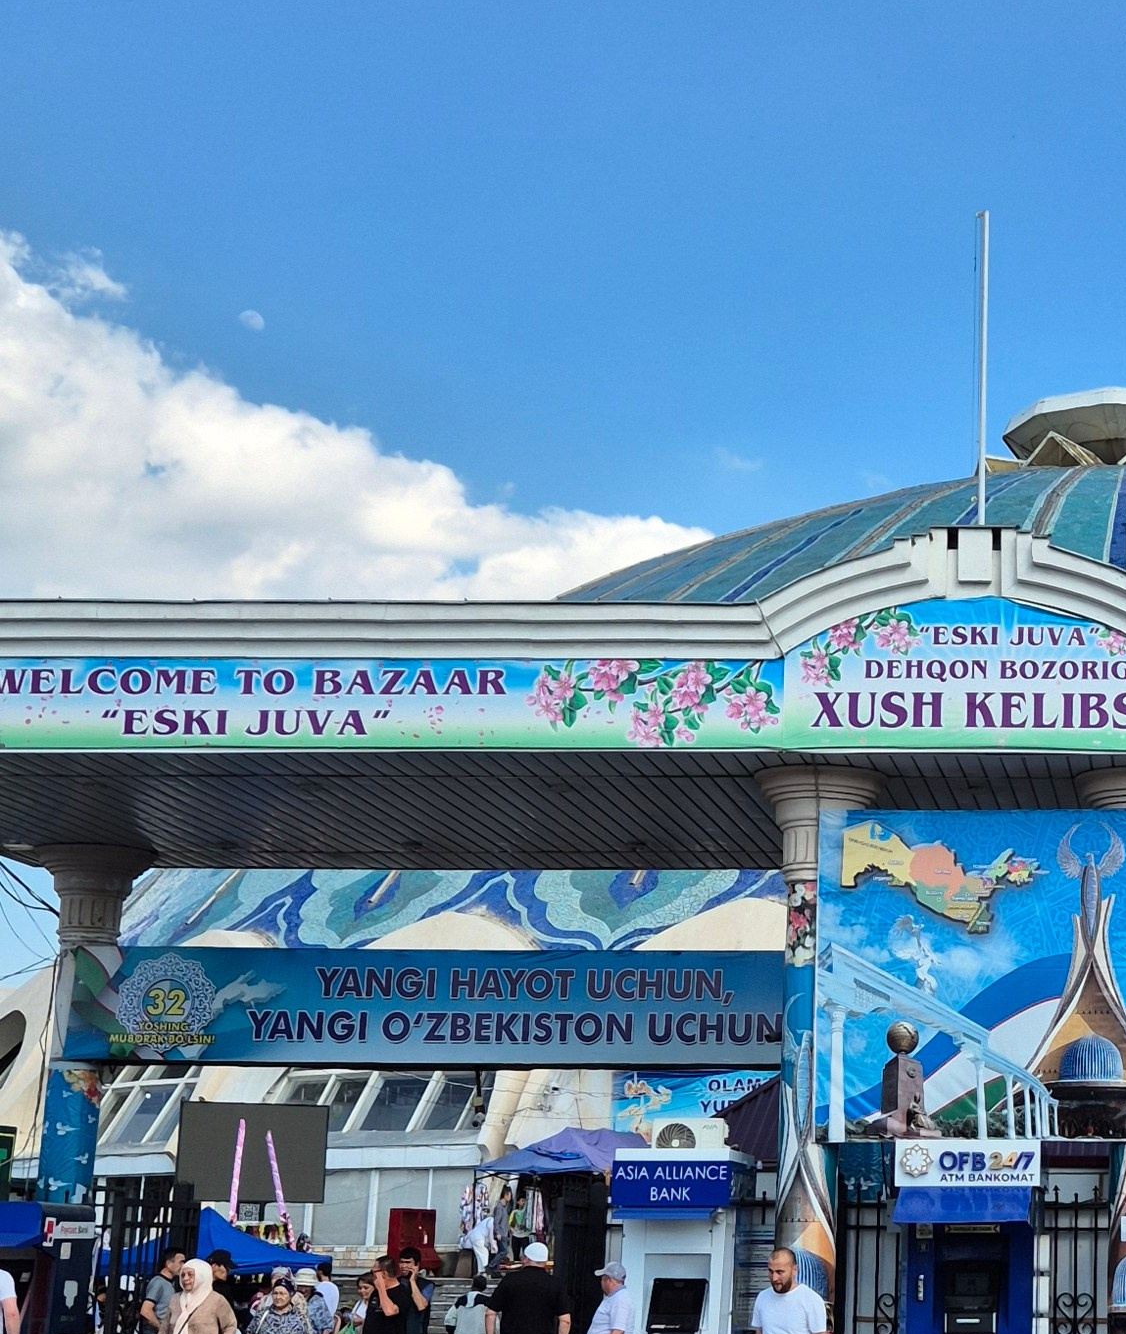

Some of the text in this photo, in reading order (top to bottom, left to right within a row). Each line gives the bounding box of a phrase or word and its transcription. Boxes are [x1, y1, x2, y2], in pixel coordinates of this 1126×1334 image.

[919, 625, 1099, 647] "ESKI JUVA"
[0, 668, 507, 696] WELCOME TO BAZAAR
[864, 659, 988, 683] DEHQON
[811, 691, 944, 728] XUSH
[101, 709, 391, 737] "ESKI JUVA"
[315, 967, 734, 1006] YANGI HAYOT UCHUN,
[146, 988, 187, 1016] 32
[138, 1022, 189, 1031] YOSHING
[247, 1010, 367, 1042] YANGI
[381, 1012, 632, 1044] O'ZBEKISTON
[109, 1034, 165, 1044] MUBORAK
[615, 1165, 728, 1180] ASIA ALLIANCE
[939, 1151, 1035, 1171] OFB 24/7
[940, 1174, 1035, 1182] ATM BANKOMAT
[650, 1187, 691, 1201] BANK
